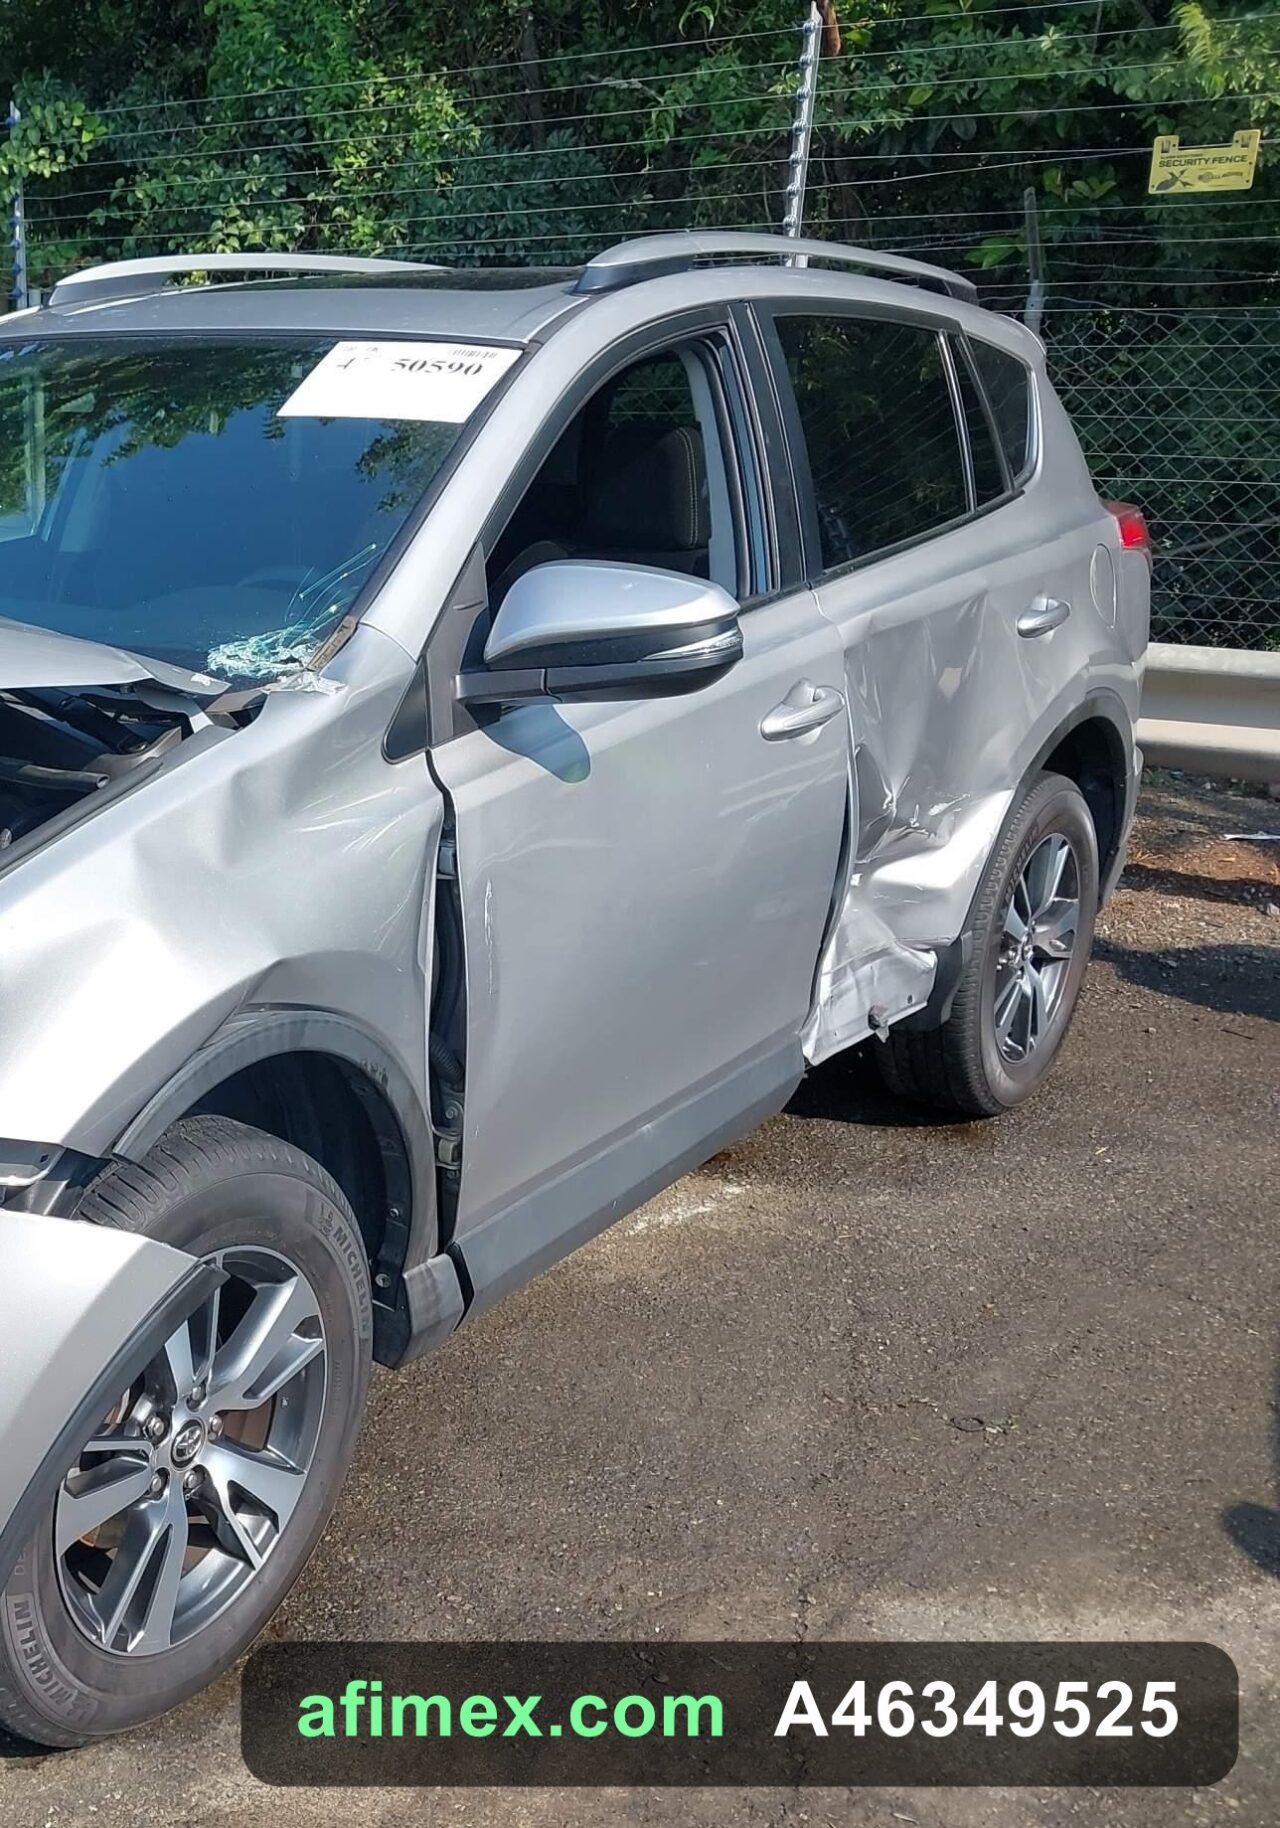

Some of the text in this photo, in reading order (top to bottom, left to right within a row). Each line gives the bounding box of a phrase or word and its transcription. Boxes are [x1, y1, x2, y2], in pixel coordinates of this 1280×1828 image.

[1158, 157, 1210, 168] SECURITY
[1212, 154, 1249, 165] FENCE
[332, 1225, 370, 1332] MICHELIN
[13, 1601, 74, 1706] MICHELIN
